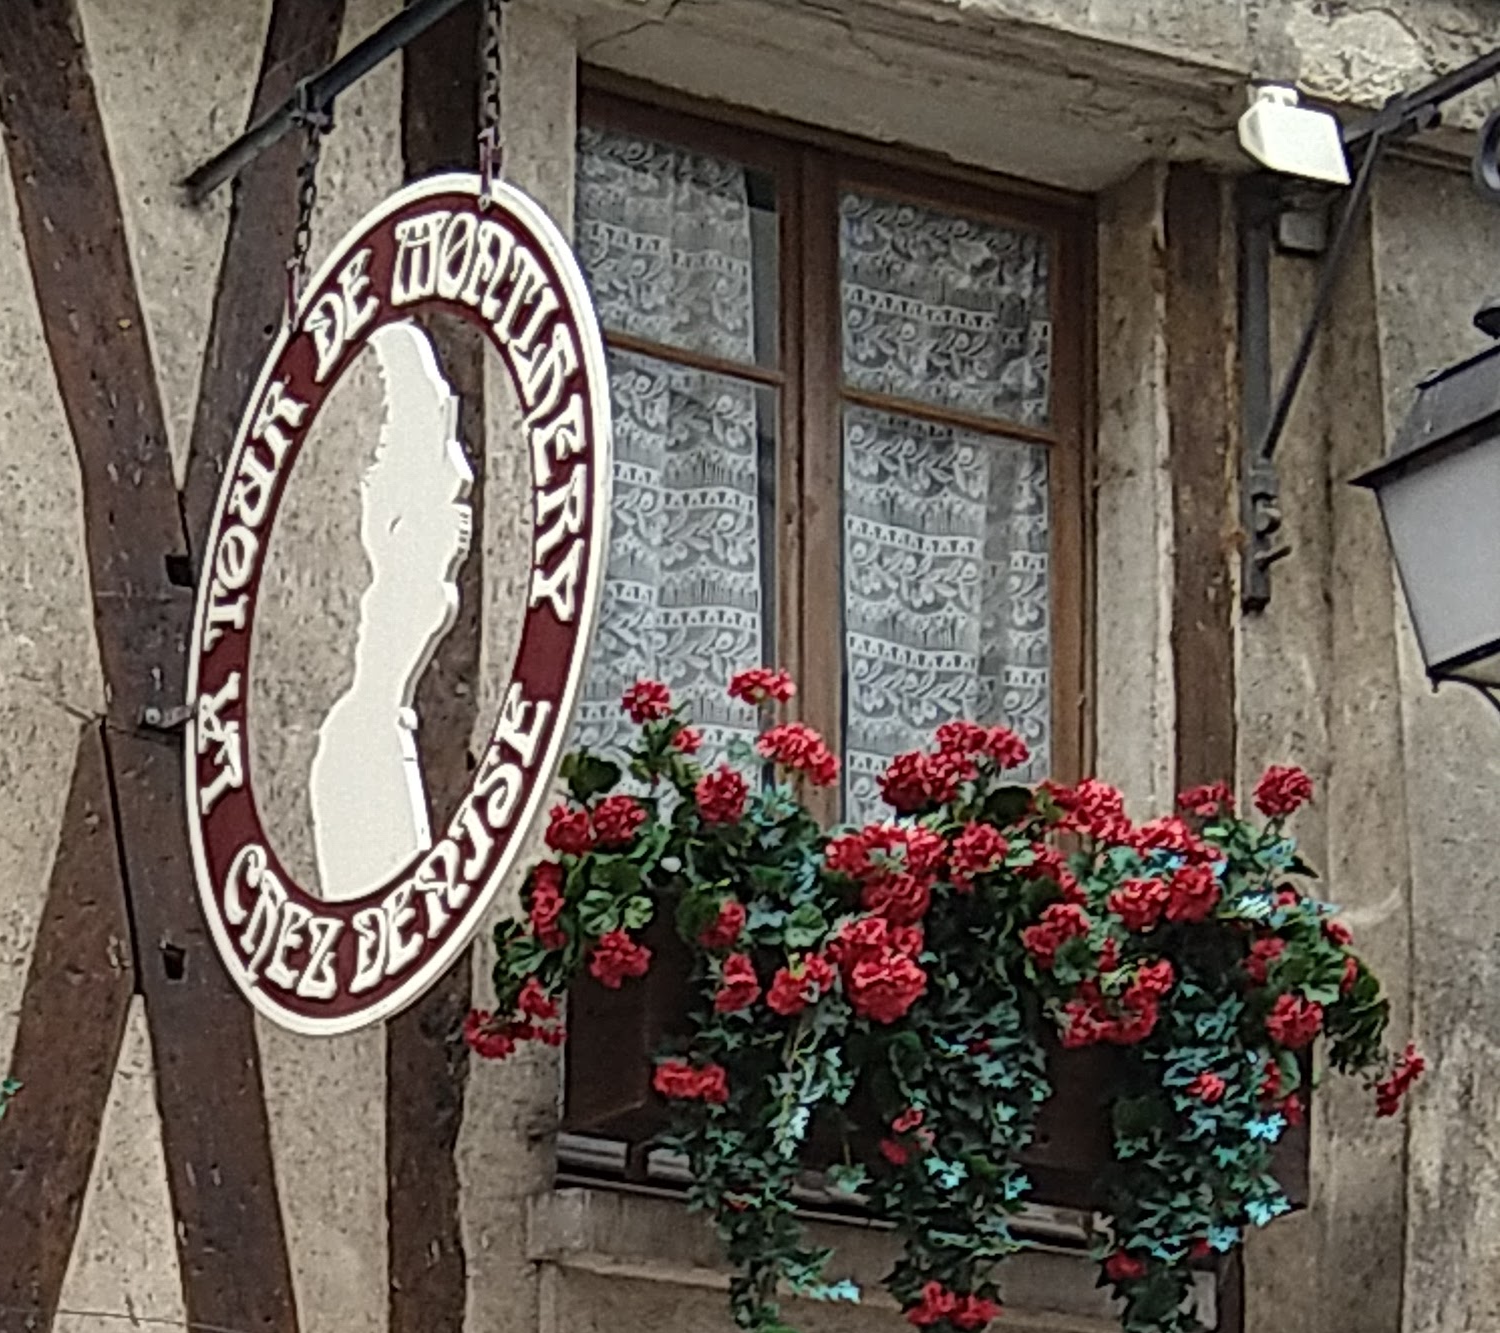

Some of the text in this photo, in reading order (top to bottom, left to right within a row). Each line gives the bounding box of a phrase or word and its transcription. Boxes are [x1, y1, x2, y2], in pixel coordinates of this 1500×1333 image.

[305, 247, 381, 384] DE
[202, 374, 307, 654] TOUR
[198, 672, 244, 815] LA
